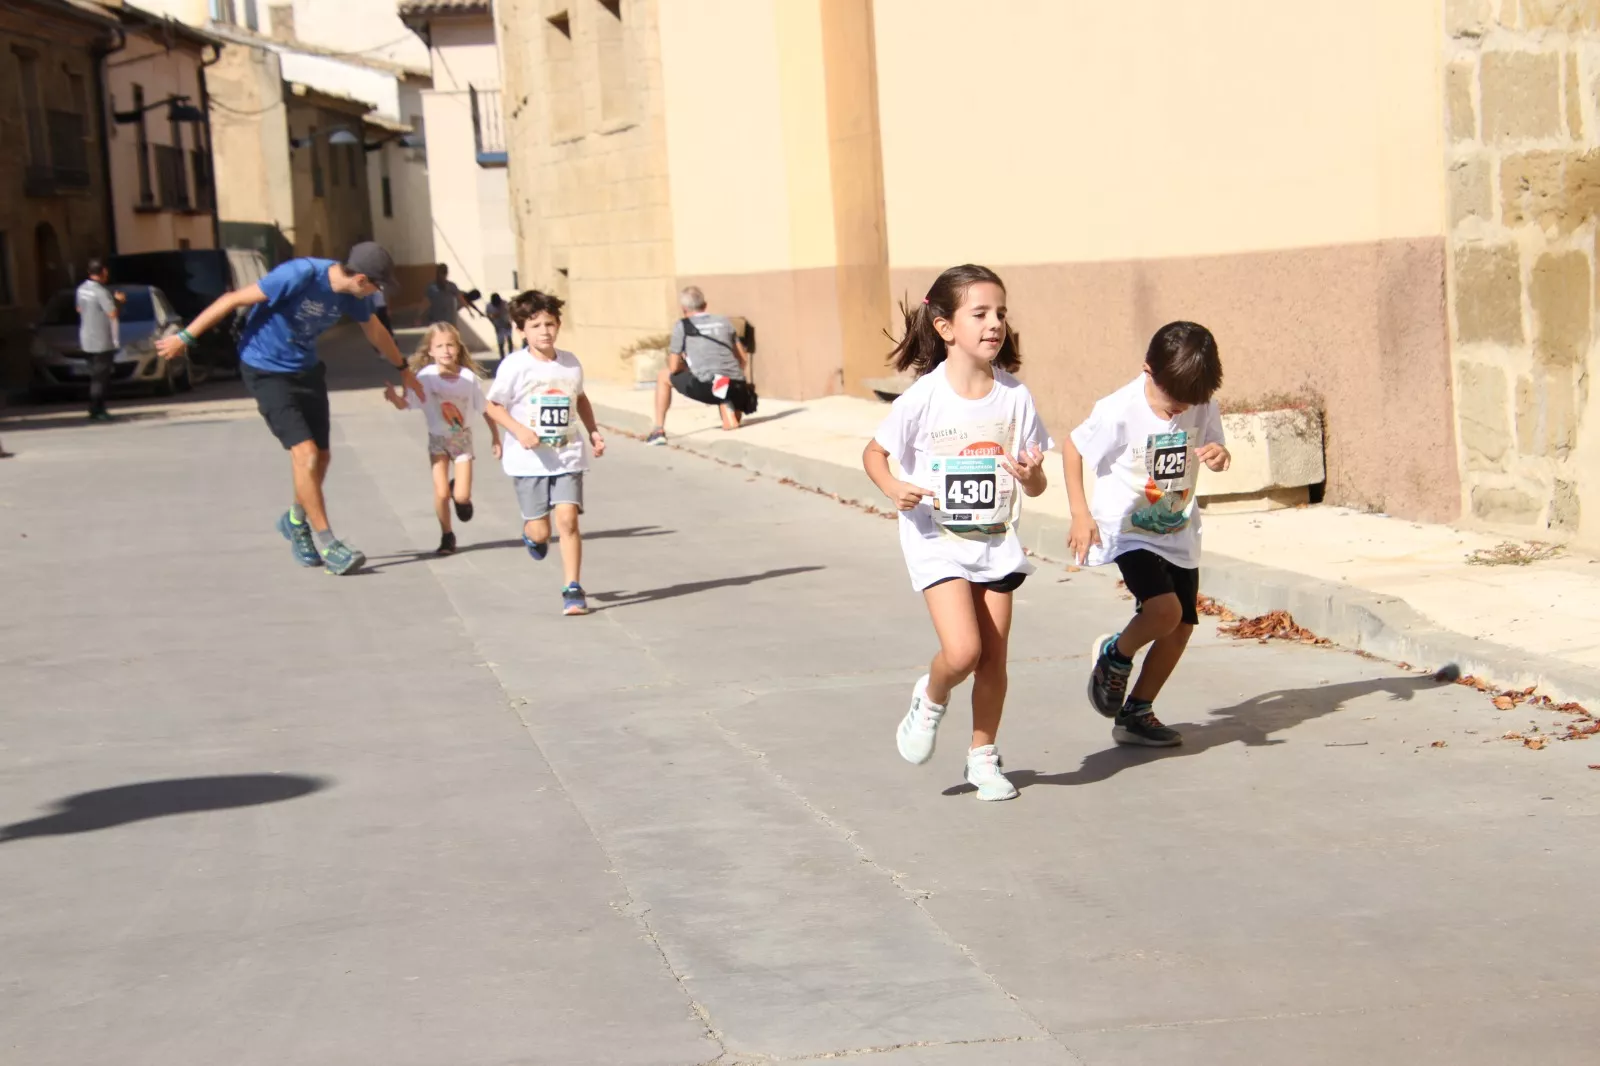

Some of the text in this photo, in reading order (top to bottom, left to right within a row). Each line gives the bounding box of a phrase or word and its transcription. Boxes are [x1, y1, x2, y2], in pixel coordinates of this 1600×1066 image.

[541, 409, 568, 424] 419
[1155, 452, 1185, 475] 425
[948, 480, 993, 503] 430
